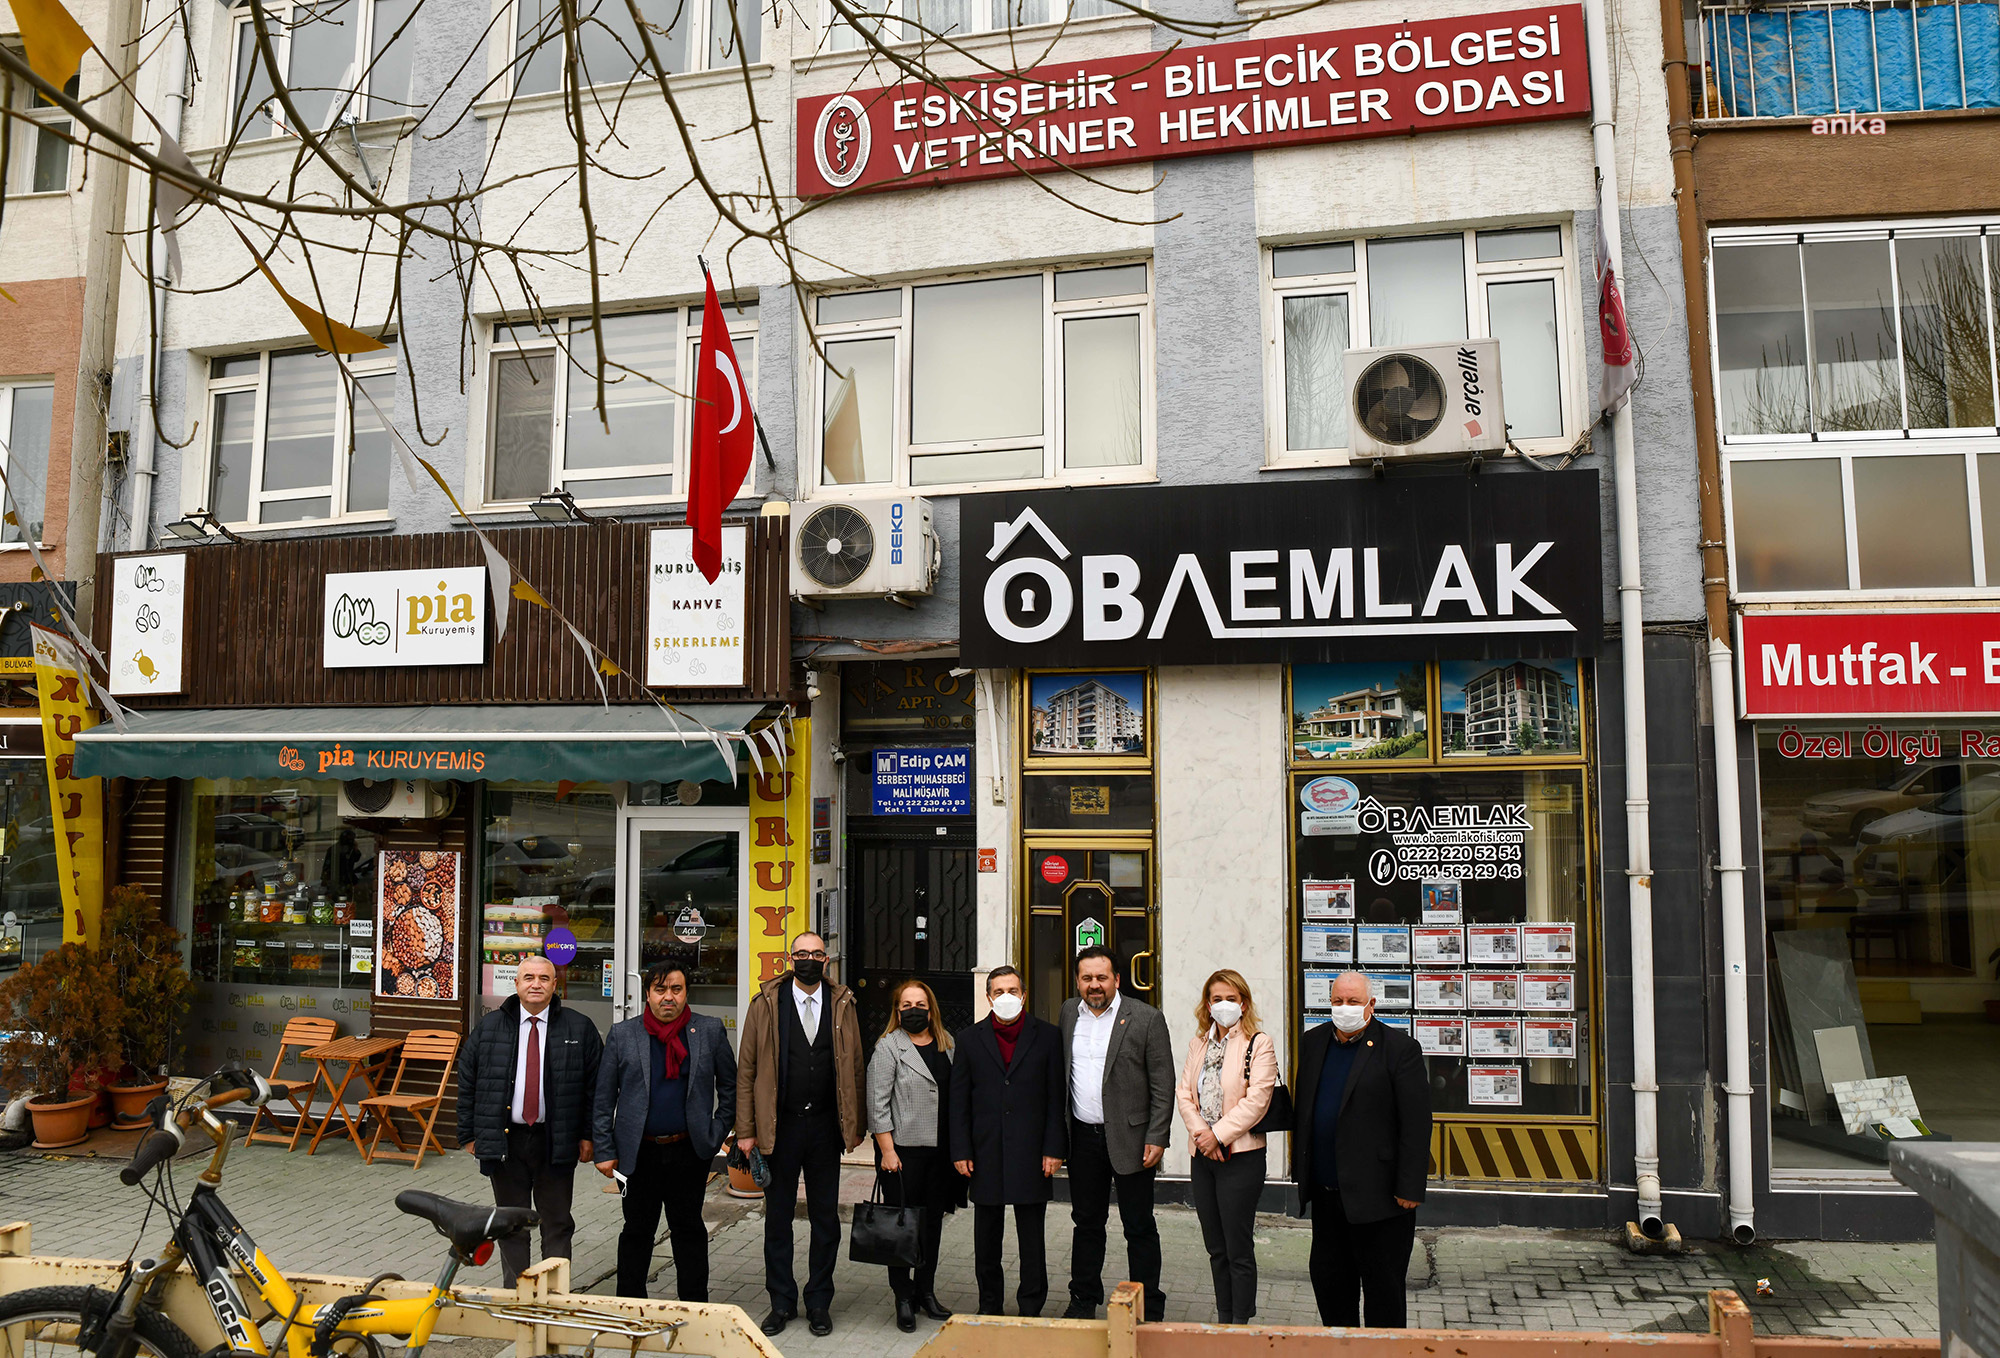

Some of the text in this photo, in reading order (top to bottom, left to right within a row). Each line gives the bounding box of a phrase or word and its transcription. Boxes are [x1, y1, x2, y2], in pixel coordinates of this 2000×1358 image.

[893, 70, 1119, 131] ESKİŞEHİR
[1164, 43, 1341, 99] BİLECİK
[1354, 15, 1560, 78] BÖLGESİ
[893, 69, 1565, 174] VETERİNER HEKİMLER ODASI
[1458, 347, 1482, 416] arçelik
[891, 503, 903, 565] BEKO
[406, 580, 475, 635] pia
[673, 599, 723, 610] KAHVE
[421, 626, 476, 636] Kuruyemiş
[654, 637, 740, 650] ŞEKERLEME
[1761, 642, 1940, 686] Mutfak
[897, 696, 942, 710] APT.
[1777, 724, 1852, 759] Özel
[1861, 724, 1941, 765] Ölçü
[318, 743, 485, 773] pia KURUYEMİŞ
[900, 755, 931, 770] Edip
[934, 754, 966, 769] ÇAM
[877, 771, 966, 785] SERBEST MUHASEBECİ
[893, 785, 950, 799] MALİ MÜŞAVİR
[1393, 832, 1523, 845] www.obaemlakofisi.com
[1398, 846, 1521, 861] 0222 220 52 54
[1398, 864, 1521, 880] 0544 562 29 46
[681, 926, 698, 936] Açık
